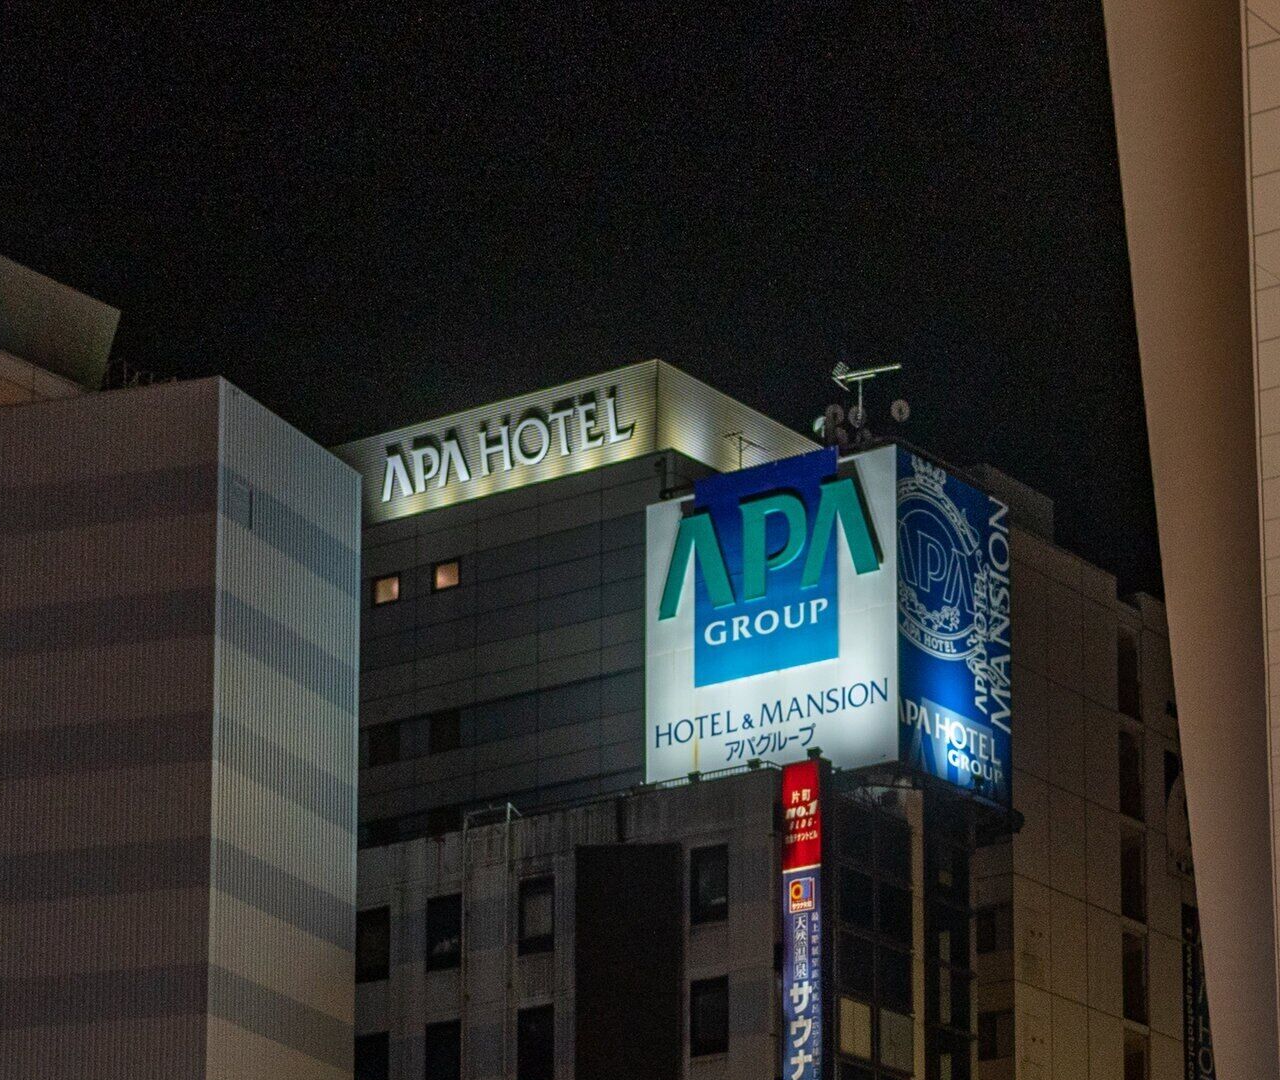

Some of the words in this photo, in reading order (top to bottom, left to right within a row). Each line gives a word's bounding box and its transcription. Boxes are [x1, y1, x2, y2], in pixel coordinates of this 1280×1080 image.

[381, 443, 469, 502] APA
[478, 394, 636, 478] HOTEL
[657, 479, 882, 622] APA
[703, 597, 829, 648] GROUP
[924, 633, 958, 655] HOTEL
[988, 496, 1012, 734] MANSION
[654, 709, 738, 749] HOTEL
[741, 713, 755, 729] &
[759, 677, 891, 728] MANSION
[935, 712, 1003, 766] HOTEL
[724, 723, 818, 762] アパグループ
[948, 749, 1003, 784] GROUP
[794, 916, 808, 979] 天然温泉
